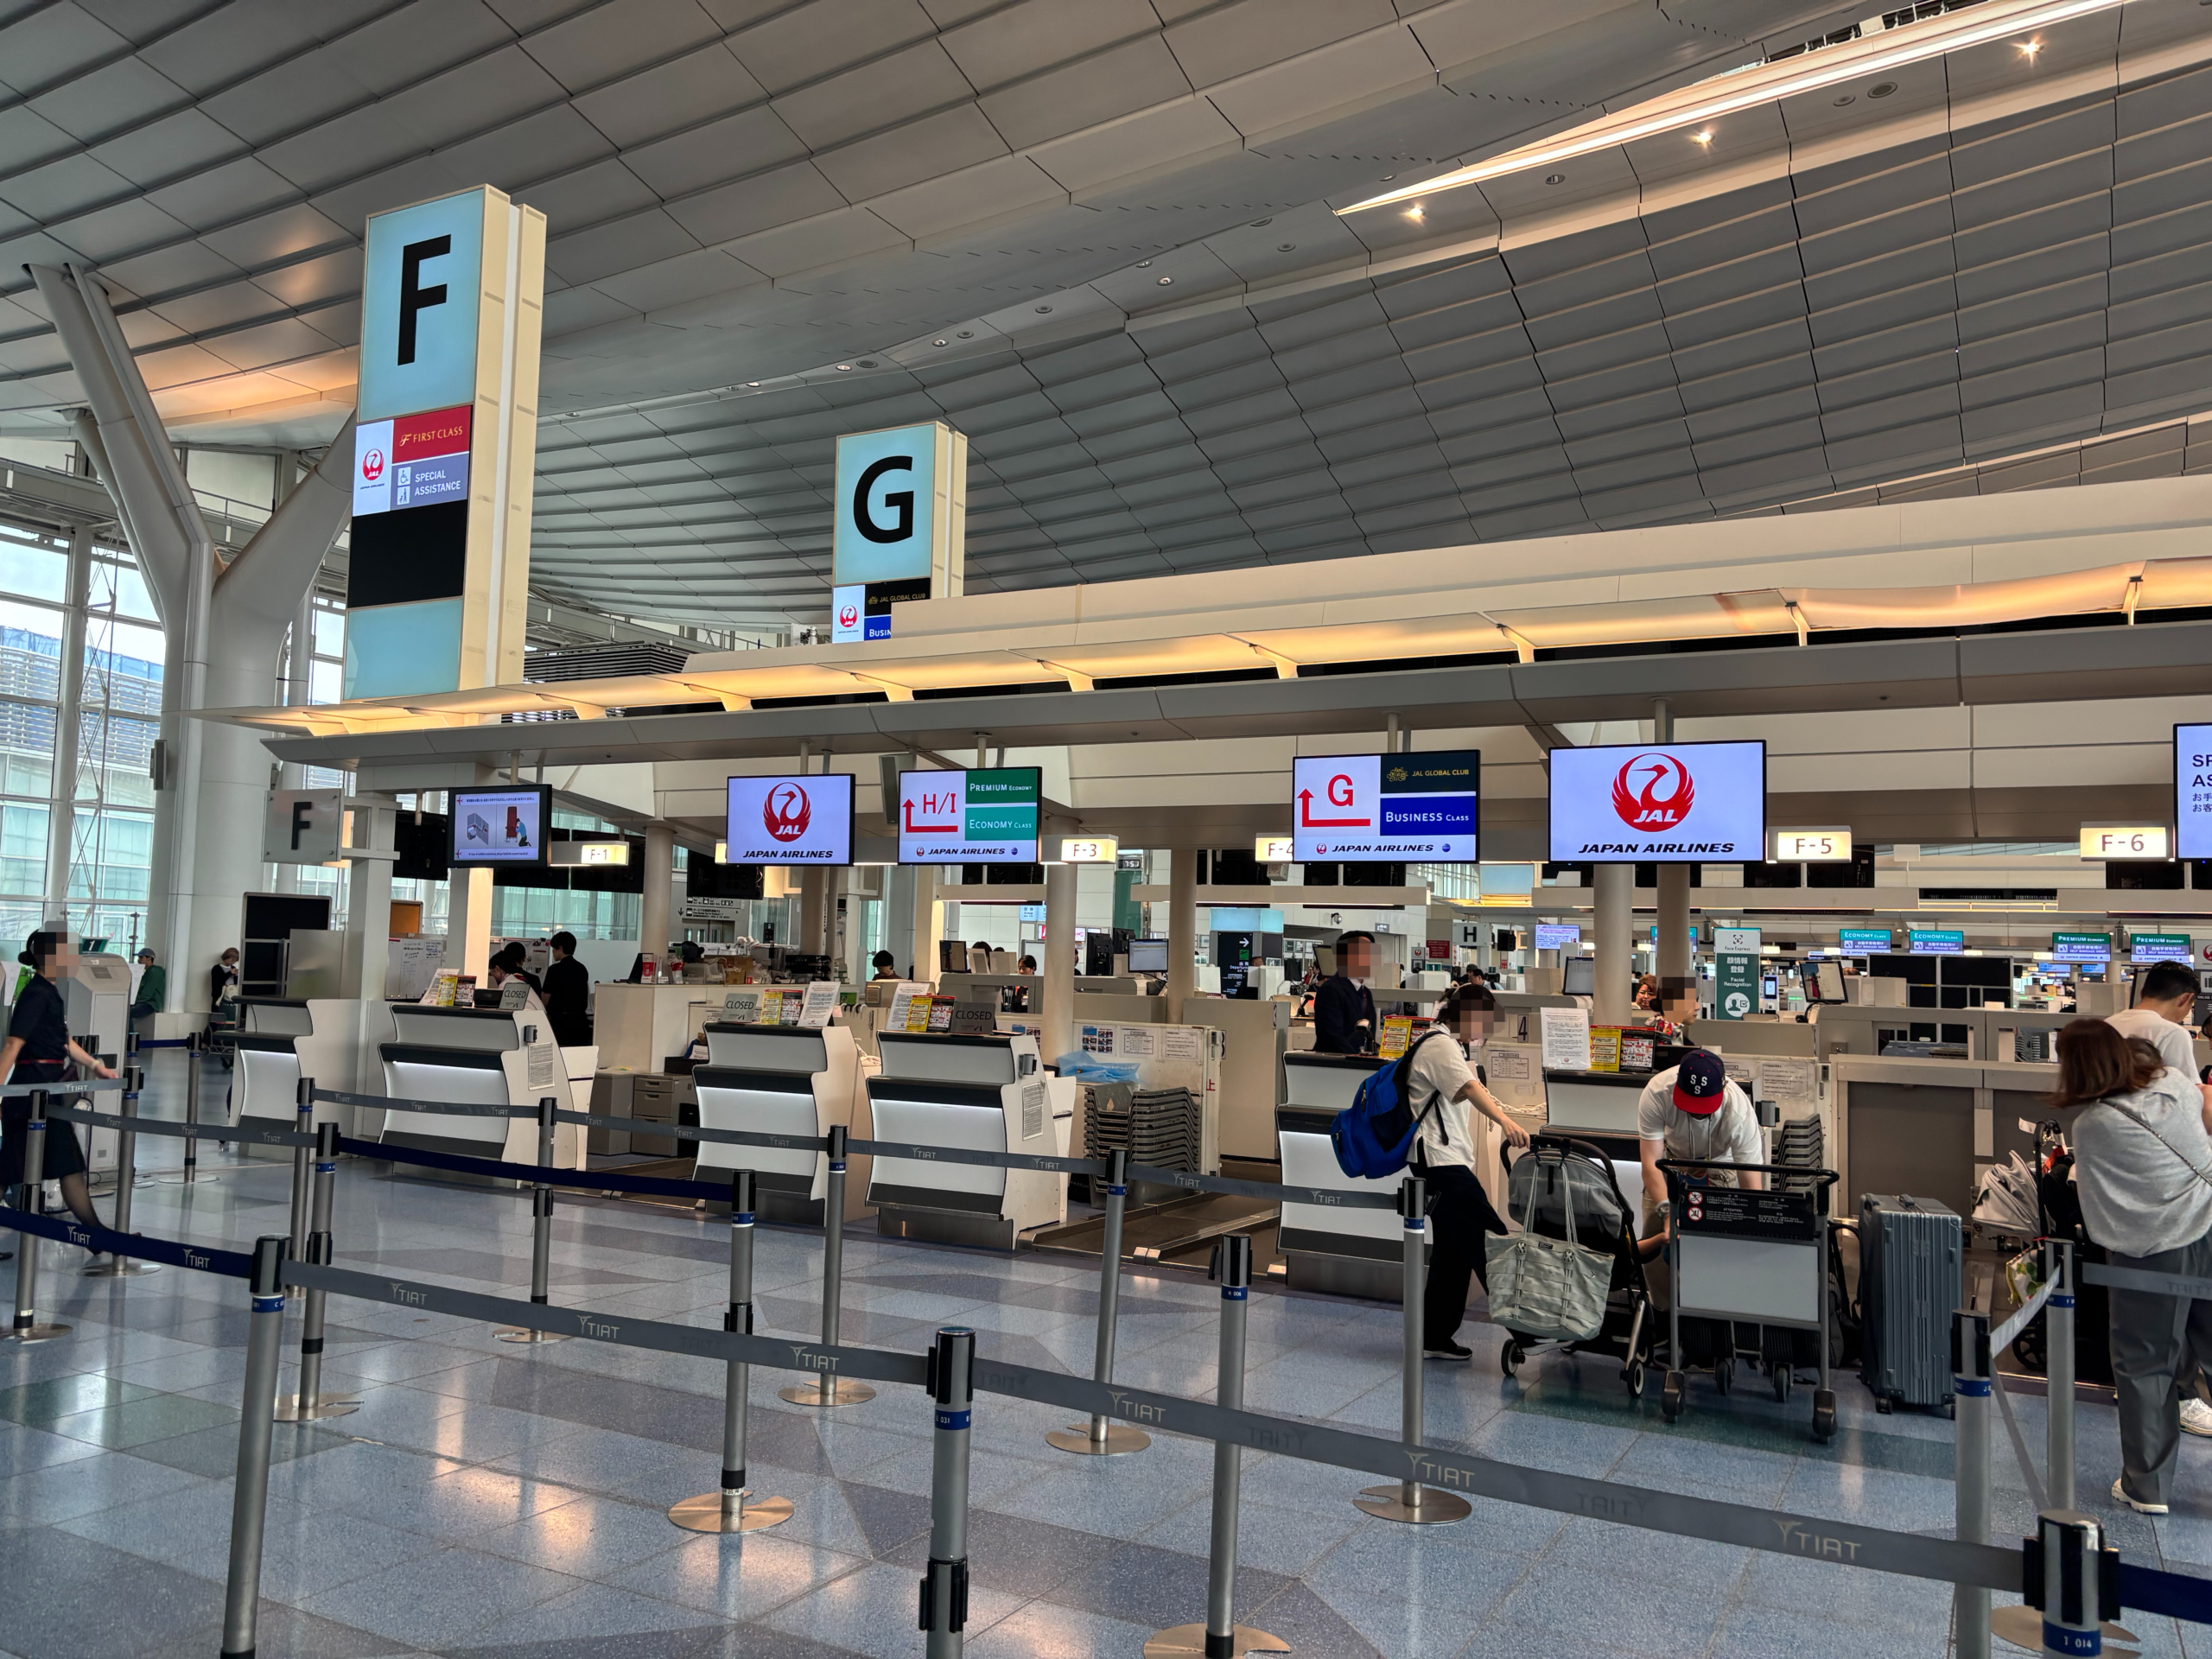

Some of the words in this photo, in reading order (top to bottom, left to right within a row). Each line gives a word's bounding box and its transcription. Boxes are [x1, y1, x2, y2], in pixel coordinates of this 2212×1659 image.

[397, 234, 451, 365] F
[413, 430, 435, 443] FIRST
[436, 426, 463, 438] CLASS
[415, 469, 447, 483] SPECIAL
[414, 480, 461, 496] ASSISTANCE
[854, 455, 914, 543] G
[969, 782, 1007, 792] PREMIUM
[1327, 773, 1354, 808] G
[922, 791, 957, 816] H/I
[1385, 810, 1443, 823] BUSINESS
[1446, 813, 1470, 822] CLASS
[1632, 810, 1679, 823] JAL
[291, 802, 312, 849] F
[774, 824, 803, 836] JAL
[969, 819, 1014, 830] ECONOMY
[1332, 844, 1372, 853] JAPAN
[1372, 843, 1434, 853] AIRLINES
[1578, 843, 1639, 854] JAPAN
[1642, 842, 1735, 854] AIRLINES
[1795, 837, 1833, 855] F-5
[2101, 834, 2145, 851] F-6
[590, 849, 607, 861] F-1
[742, 850, 779, 859] JAPAN
[779, 850, 834, 859] AIRLINES
[927, 847, 959, 855] JAPAN
[960, 847, 1006, 855] AIRLINES
[1073, 843, 1097, 857] F-3
[1463, 926, 1478, 943] H
[88, 940, 96, 951] 1
[504, 989, 526, 999] CLOSED
[726, 1001, 754, 1010] CLOSED
[955, 1010, 992, 1020] CLOSED
[1518, 1015, 1528, 1041] 4
[1690, 1074, 1697, 1084] S
[1700, 1076, 1707, 1086] S
[1694, 1085, 1701, 1095] S
[916, 1150, 937, 1160] TIAT
[1039, 1161, 1060, 1170] TIAT
[1179, 1177, 1200, 1188] TIAT
[1318, 1194, 1342, 1205] TIAT
[73, 1231, 92, 1245] TIAT
[188, 1255, 210, 1268] TIAT
[398, 1288, 429, 1306] TIAT
[587, 1322, 620, 1339] TIAT
[802, 1353, 840, 1370] TIAT
[1122, 1400, 1166, 1423] TIAT
[1421, 1461, 1476, 1488] TIAT
[1794, 1531, 1862, 1560] TIAT
